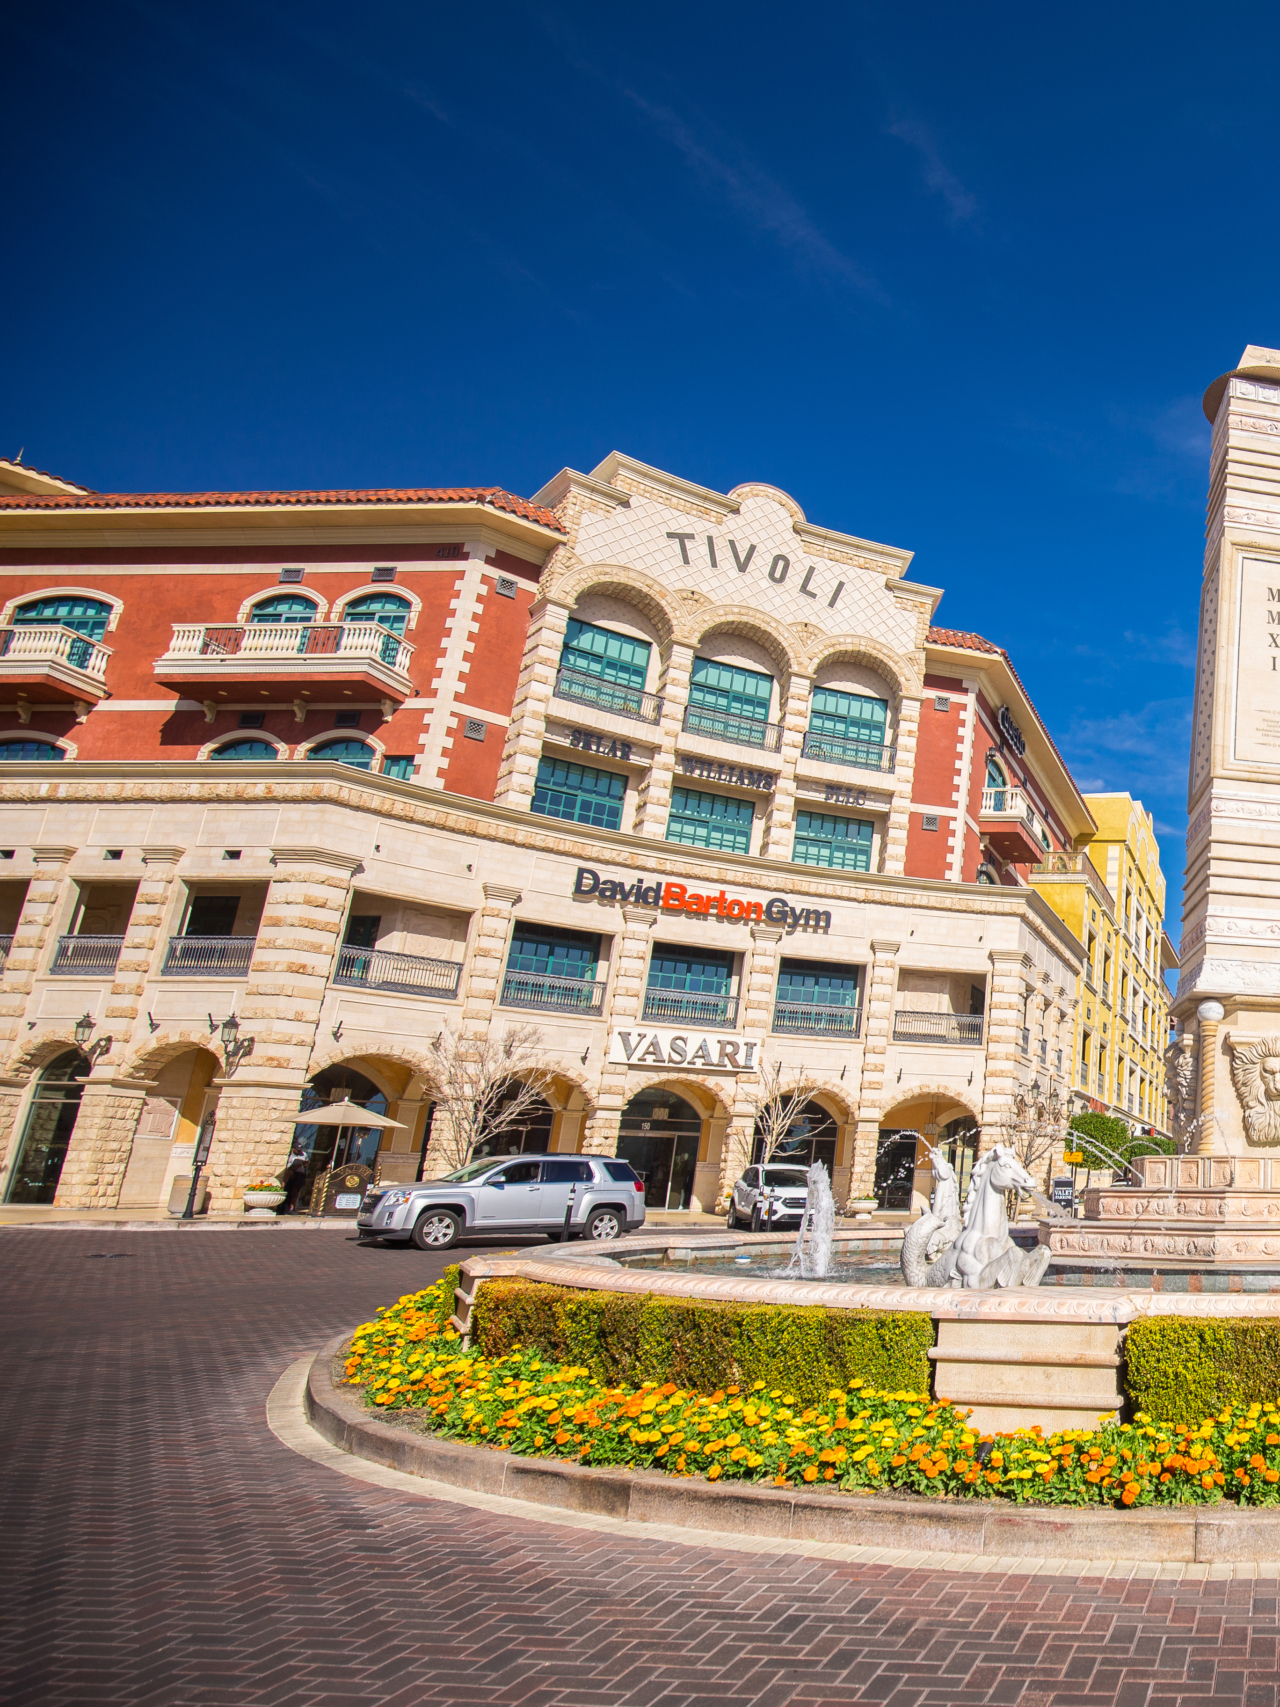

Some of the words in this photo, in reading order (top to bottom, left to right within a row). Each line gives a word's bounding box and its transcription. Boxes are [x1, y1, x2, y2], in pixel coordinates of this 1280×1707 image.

[435, 546, 459, 558] 410
[666, 532, 845, 608] TIVOLI
[569, 729, 632, 761] SKLAR
[681, 757, 774, 790] WILLIAMS
[824, 785, 867, 806] PLLC
[618, 1031, 757, 1070] VASARI
[642, 1122, 650, 1130] 150
